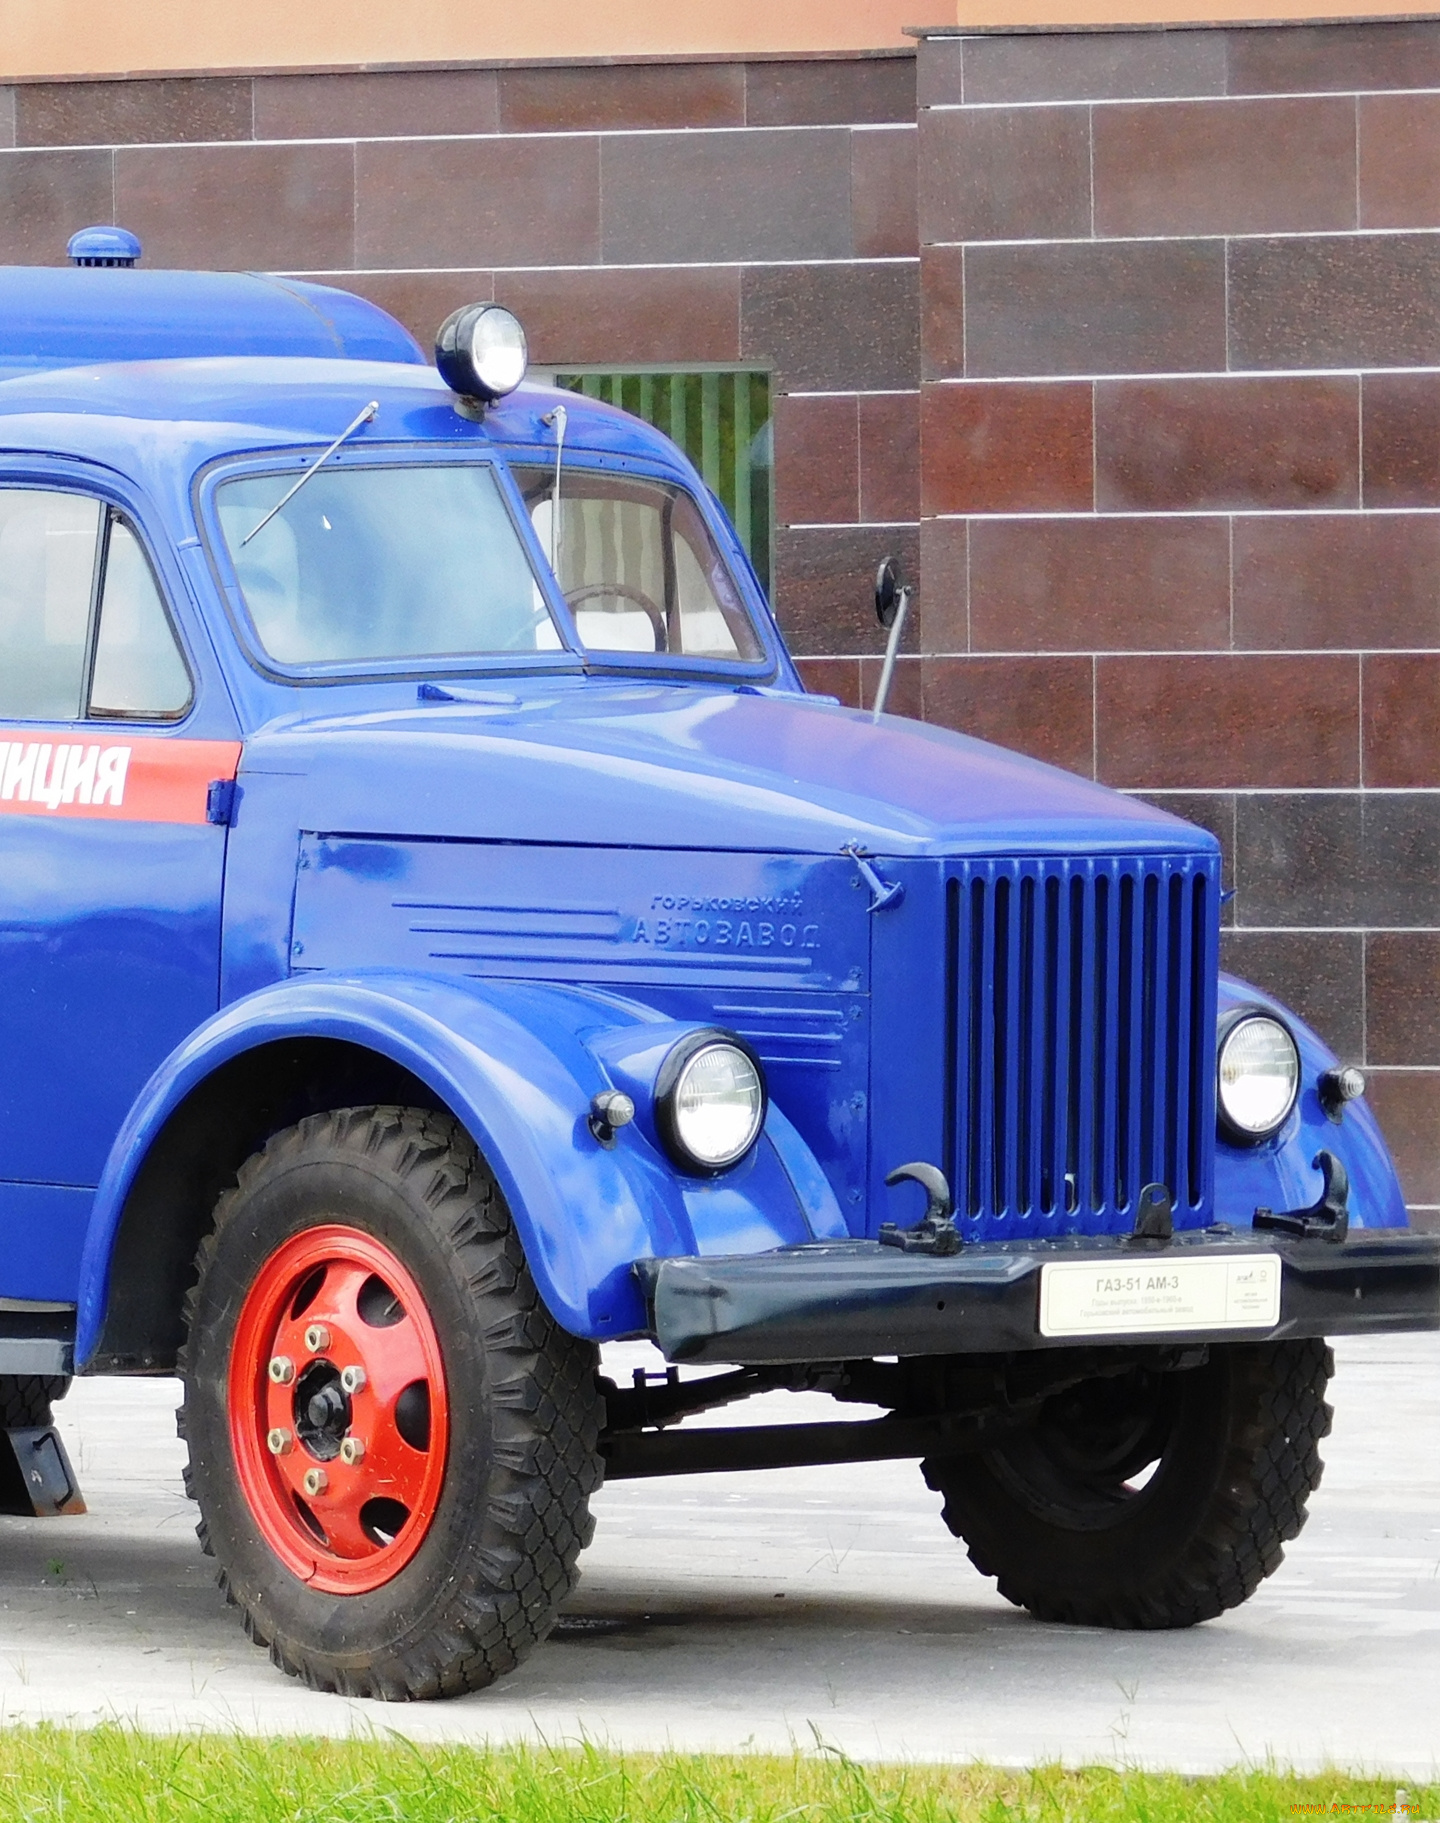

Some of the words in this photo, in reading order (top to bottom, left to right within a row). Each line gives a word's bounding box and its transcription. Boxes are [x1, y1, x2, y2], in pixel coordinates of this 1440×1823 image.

[632, 916, 821, 949] АВТОЗАВОД
[1095, 1277, 1141, 1293] ГАЗ-51
[1146, 1275, 1180, 1291] АМ-3
